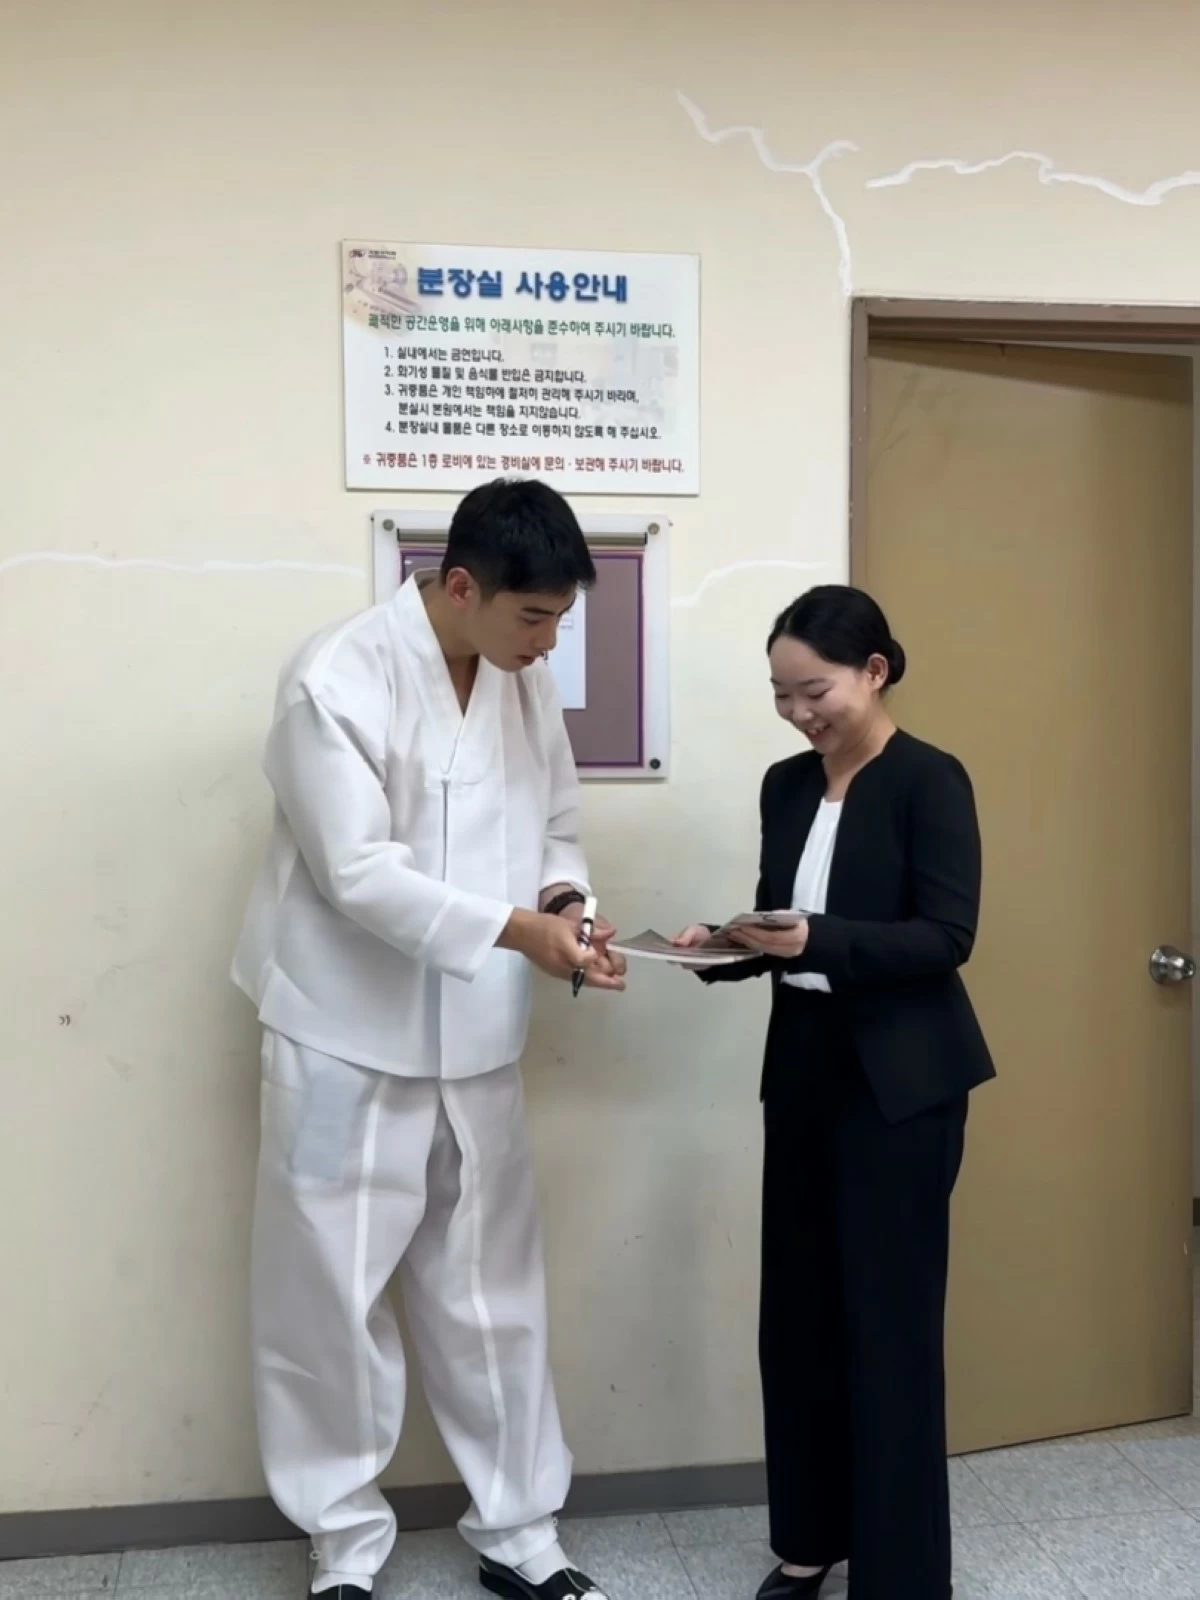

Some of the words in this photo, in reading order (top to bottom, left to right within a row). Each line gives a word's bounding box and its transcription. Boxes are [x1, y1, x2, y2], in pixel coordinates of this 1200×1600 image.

[417, 266, 503, 299] 분장실
[515, 270, 628, 303] 사용안내
[368, 313, 401, 330] 쾌적한
[405, 315, 460, 332] 공간운영을
[464, 317, 486, 333] 위해
[490, 317, 544, 335] 아래사항을
[547, 319, 591, 336] 준수하여
[594, 320, 627, 337] 주시기
[630, 322, 676, 338] 바랍니다.
[384, 346, 393, 358] 1.
[397, 347, 447, 360] 실내에서는
[451, 348, 504, 362] 금연입니다.
[384, 365, 394, 377] 2.
[397, 365, 428, 379] 화기성
[431, 366, 451, 380] 물질
[455, 367, 464, 380] 및
[468, 367, 498, 381] 음식물
[501, 368, 531, 382] 반입은
[534, 368, 587, 383] 금지합니다.
[384, 384, 394, 396] 3.
[398, 384, 438, 398] 귀중품은
[441, 385, 462, 398] 개인
[465, 386, 505, 399] 책임하에
[508, 387, 538, 400] 철저히
[541, 387, 571, 401] 관리해
[574, 388, 604, 402] 주시기
[607, 389, 639, 403] 바라며,
[398, 402, 429, 416] 분실시
[432, 403, 482, 417] 본원에서는
[486, 404, 515, 418] 책임을
[519, 405, 581, 419] 지지않습니다.
[385, 421, 395, 433] 4.
[398, 421, 439, 434] 분장실내
[442, 422, 472, 435] 물품은
[475, 422, 496, 436] 다른
[499, 423, 528, 437] 장소로
[531, 424, 571, 438] 이동하지
[574, 425, 604, 438] 않도록
[607, 425, 617, 439] 해
[620, 426, 661, 439] 주십시오.
[376, 452, 417, 467] 귀중품은
[422, 453, 438, 468] 1층
[442, 454, 472, 469] 로비에
[476, 455, 496, 469] 있는
[500, 455, 541, 470] 경비실에
[544, 456, 565, 471] 문의
[574, 457, 605, 471] 보관해
[608, 458, 638, 472] 주시기
[641, 458, 684, 473] 바랍니다.
